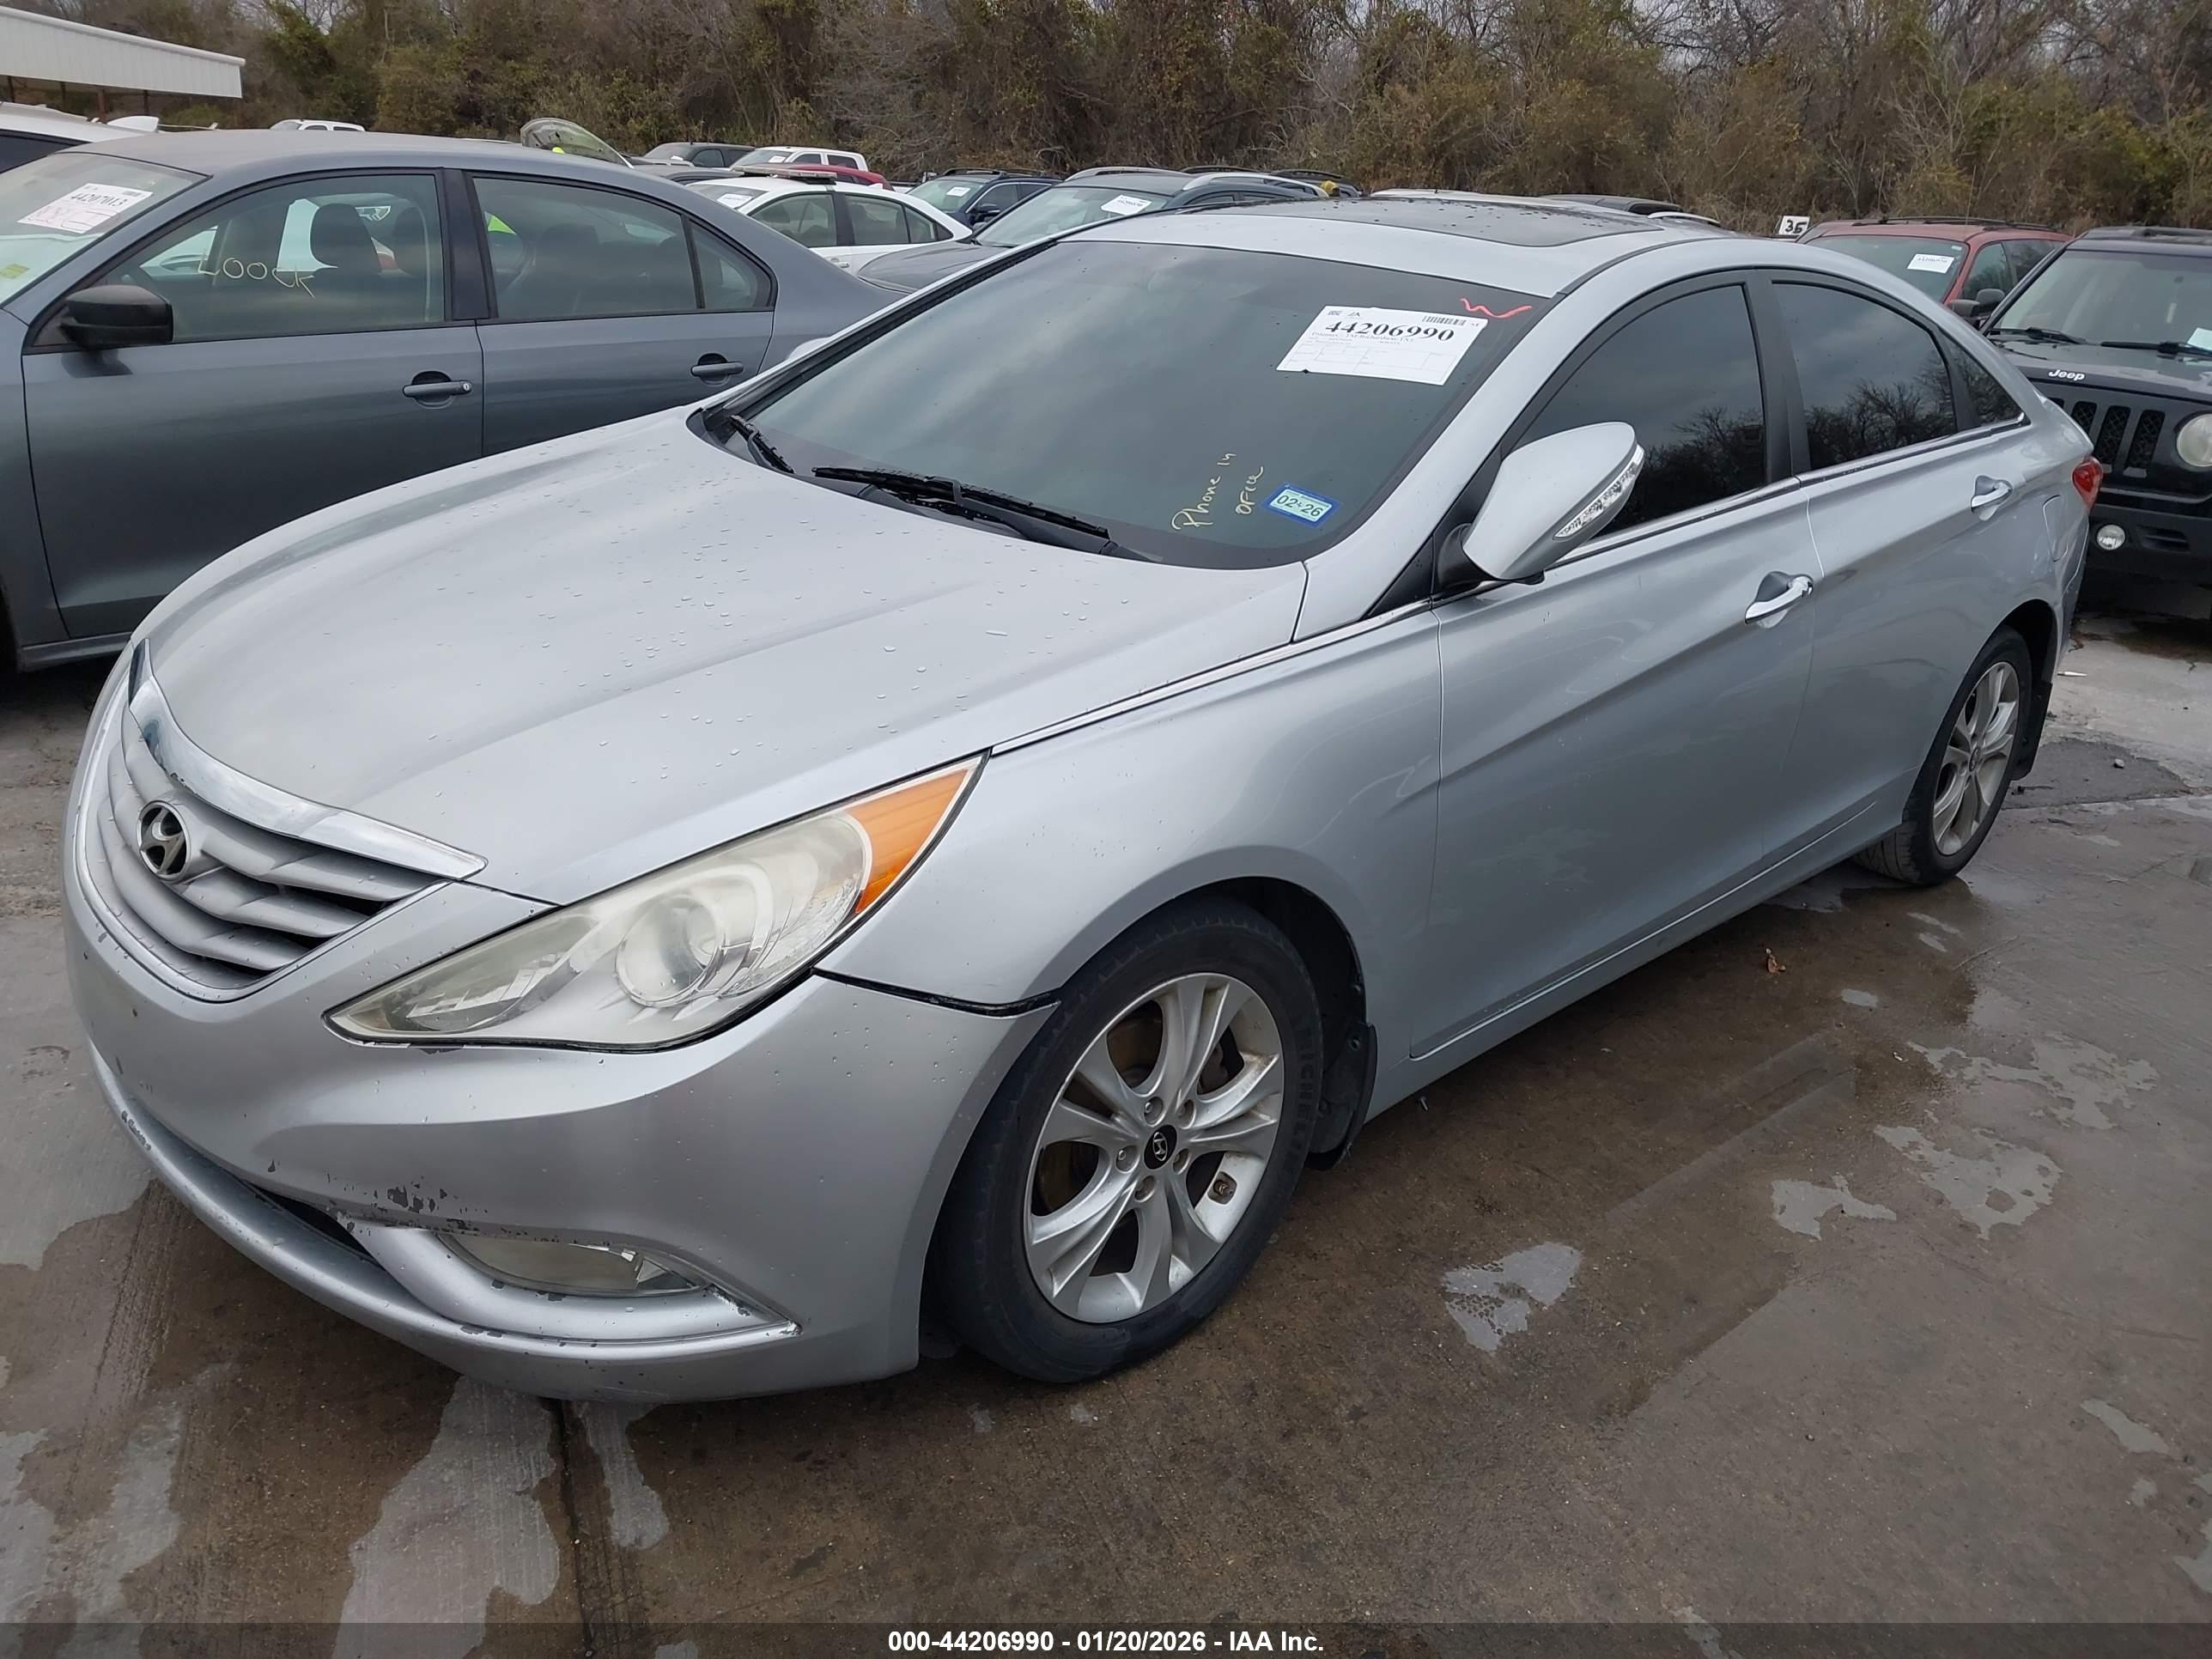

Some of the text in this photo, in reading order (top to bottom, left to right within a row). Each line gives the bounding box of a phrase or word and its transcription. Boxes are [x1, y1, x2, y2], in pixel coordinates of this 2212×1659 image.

[1785, 219, 1807, 234] 35
[1325, 321, 1455, 342] 44206990
[2048, 369, 2085, 381] Jeep
[1171, 476, 1221, 530] Phone
